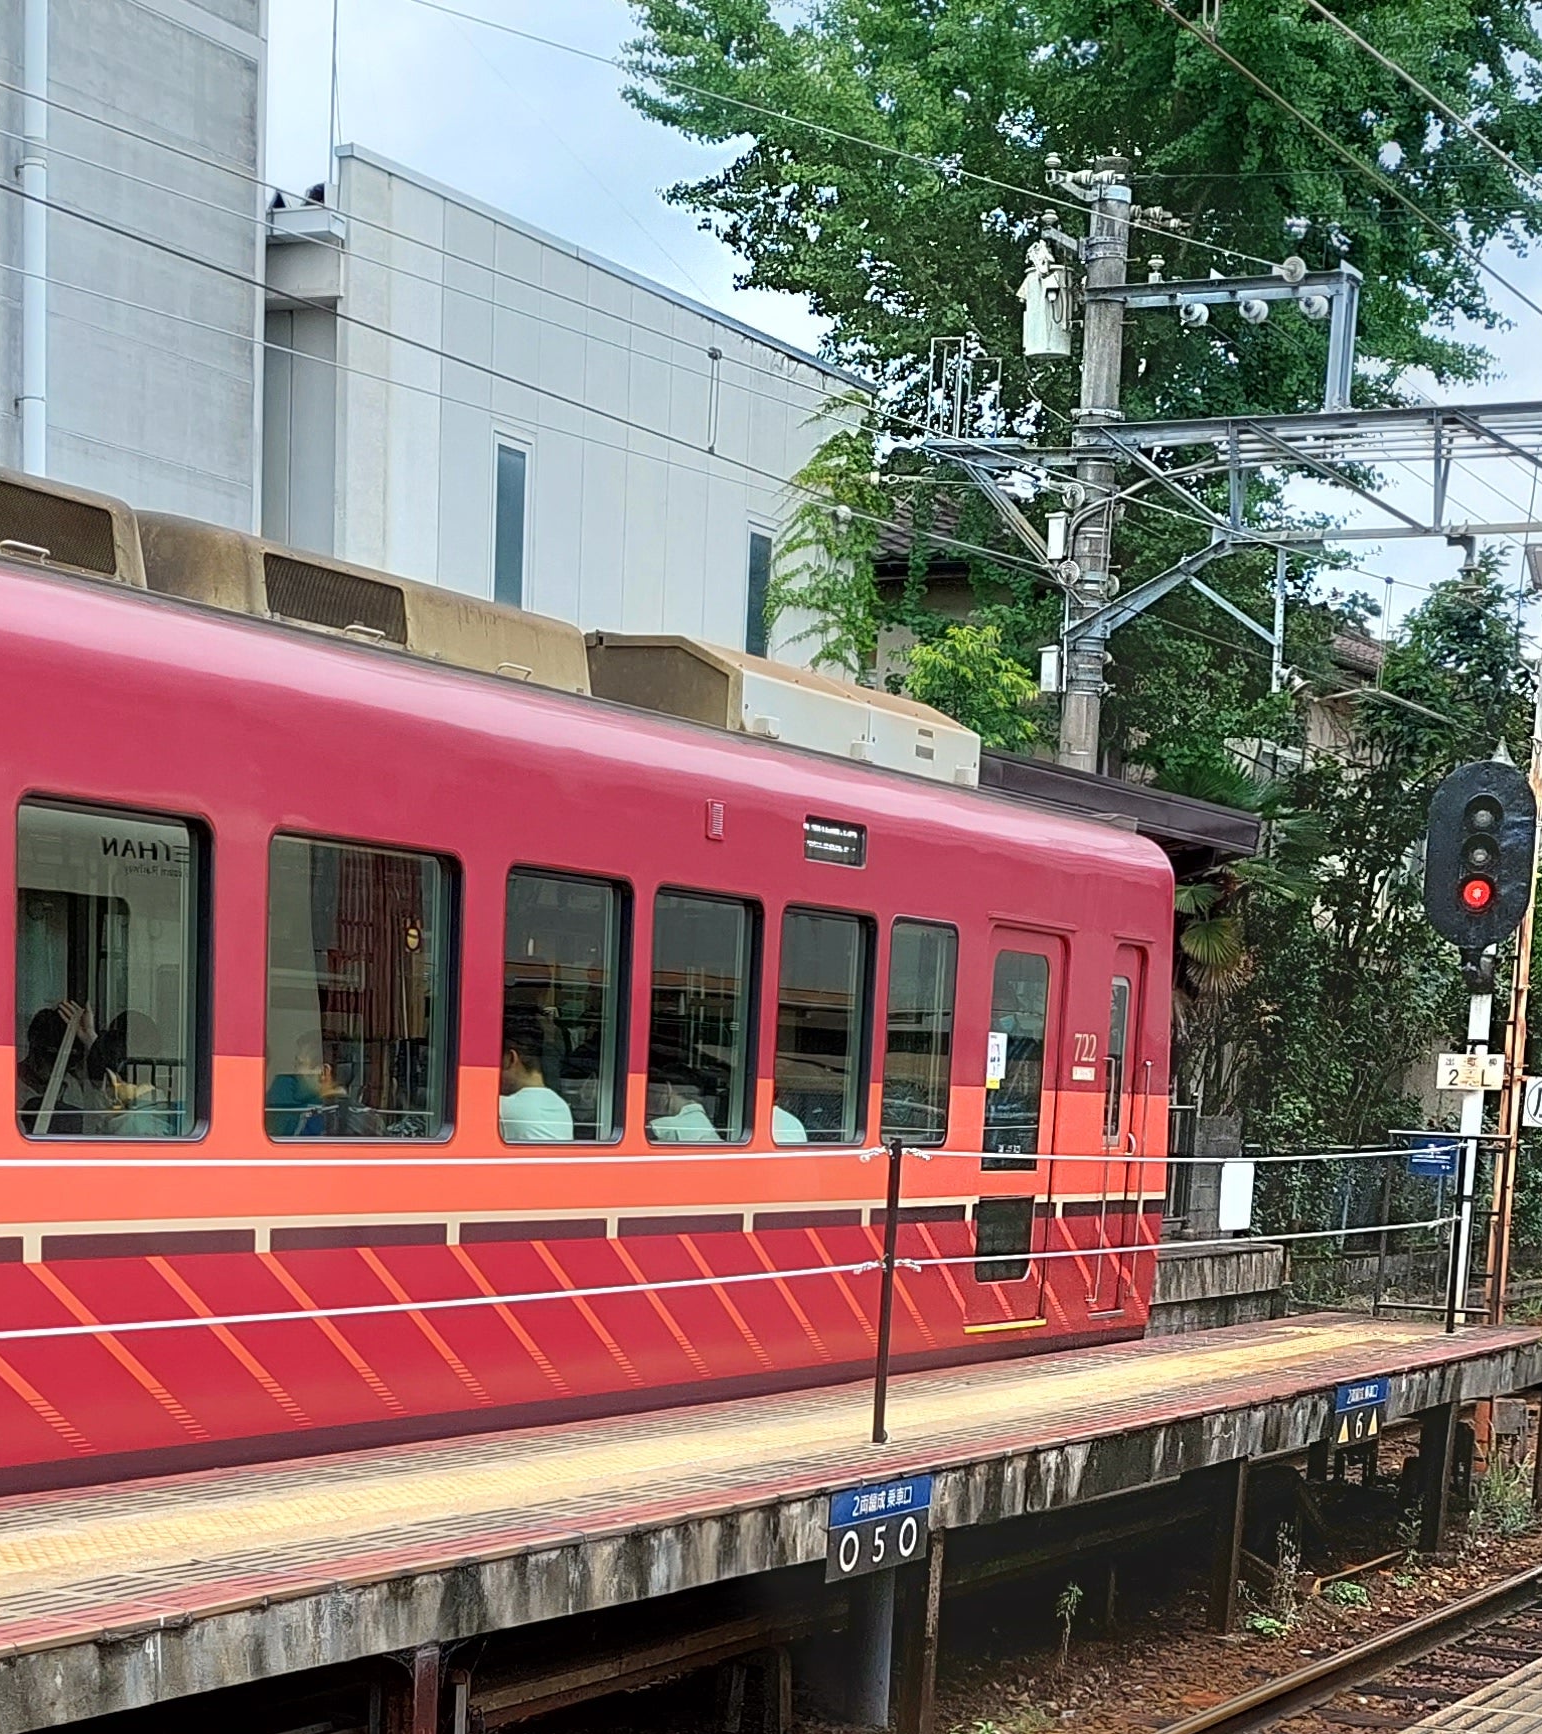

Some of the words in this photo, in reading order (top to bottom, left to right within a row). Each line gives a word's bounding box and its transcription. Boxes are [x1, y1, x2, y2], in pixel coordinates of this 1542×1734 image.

[1074, 1033, 1097, 1062] 722
[1448, 1068, 1460, 1086] 2
[1480, 1068, 1492, 1087] L
[1355, 1411, 1364, 1439] 6
